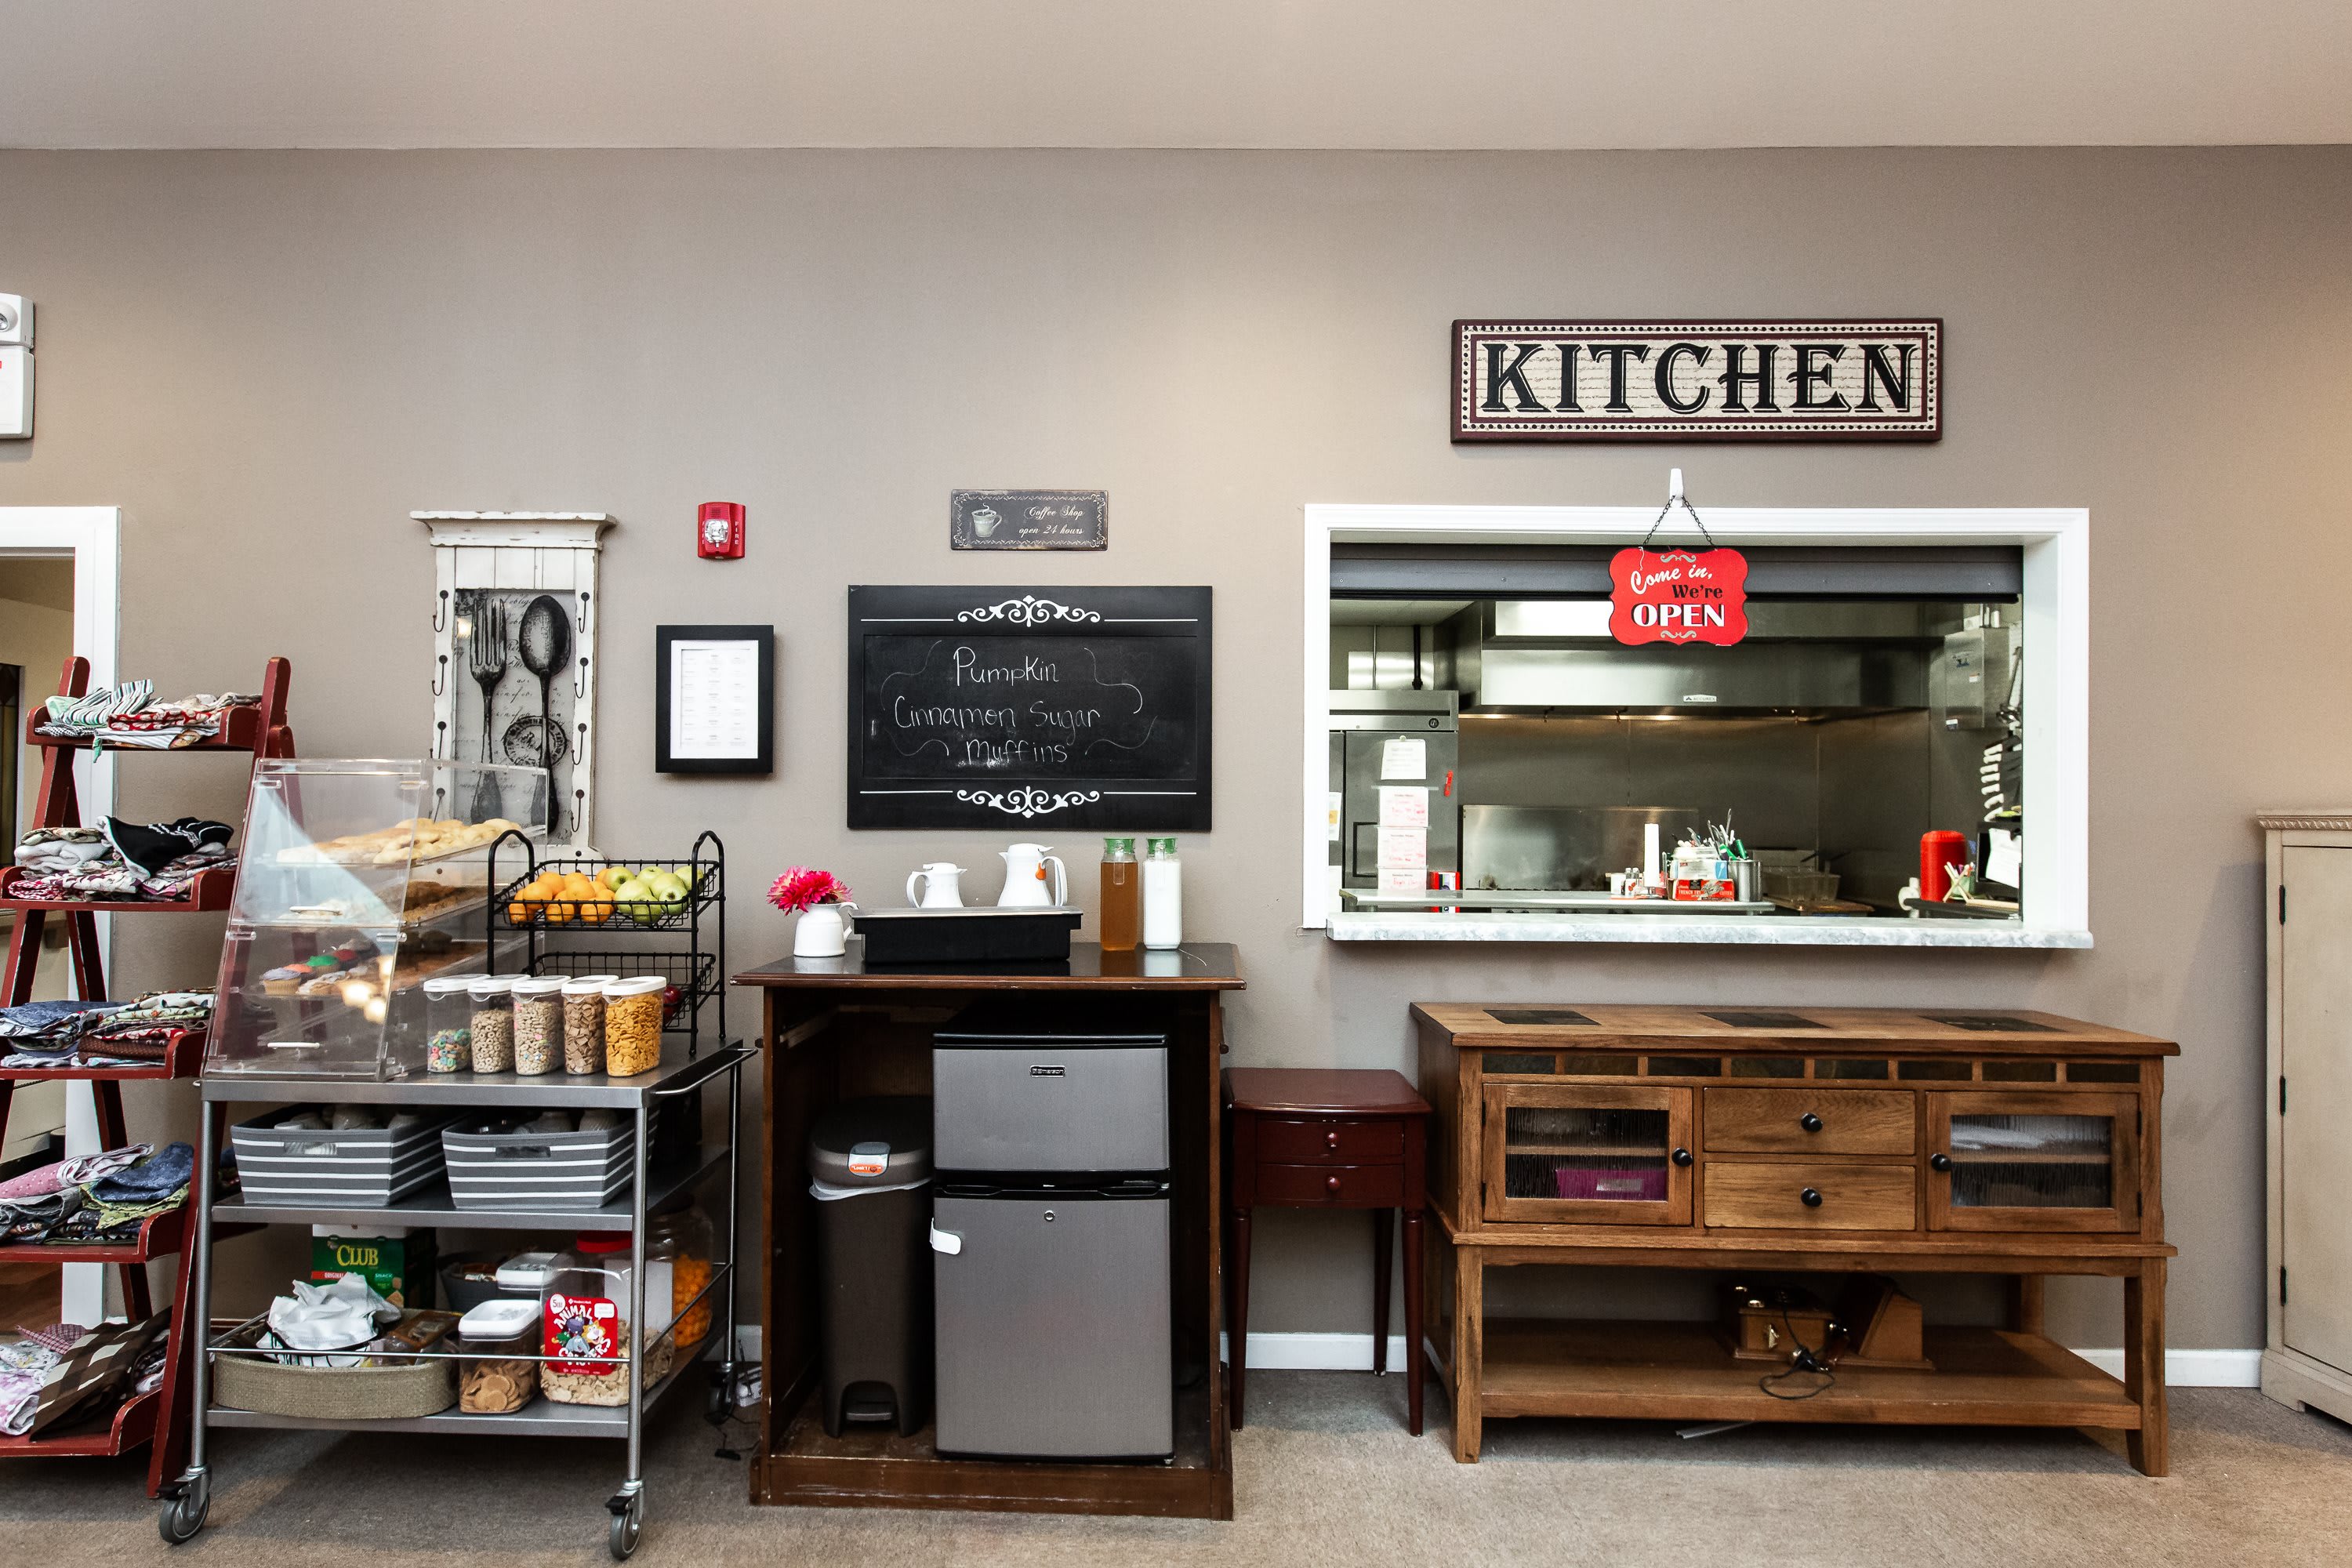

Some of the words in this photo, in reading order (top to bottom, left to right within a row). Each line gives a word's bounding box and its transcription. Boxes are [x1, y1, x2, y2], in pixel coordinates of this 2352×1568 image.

[1480, 342, 1919, 414] KITCHEN
[1023, 506, 1056, 521] Coffee
[1060, 505, 1085, 521] Shop
[1019, 528, 1040, 539] open
[1044, 524, 1058, 535] 24
[1060, 524, 1084, 535] hours
[1630, 567, 1682, 595] Come
[1688, 564, 1713, 580] in,
[1671, 584, 1723, 599] We're
[1631, 603, 1725, 627] OPEN
[894, 695, 1016, 729] Cinnamon
[1029, 700, 1101, 746] Sugar
[337, 1245, 379, 1266] CLUB
[554, 1304, 593, 1330] ANIMAL
